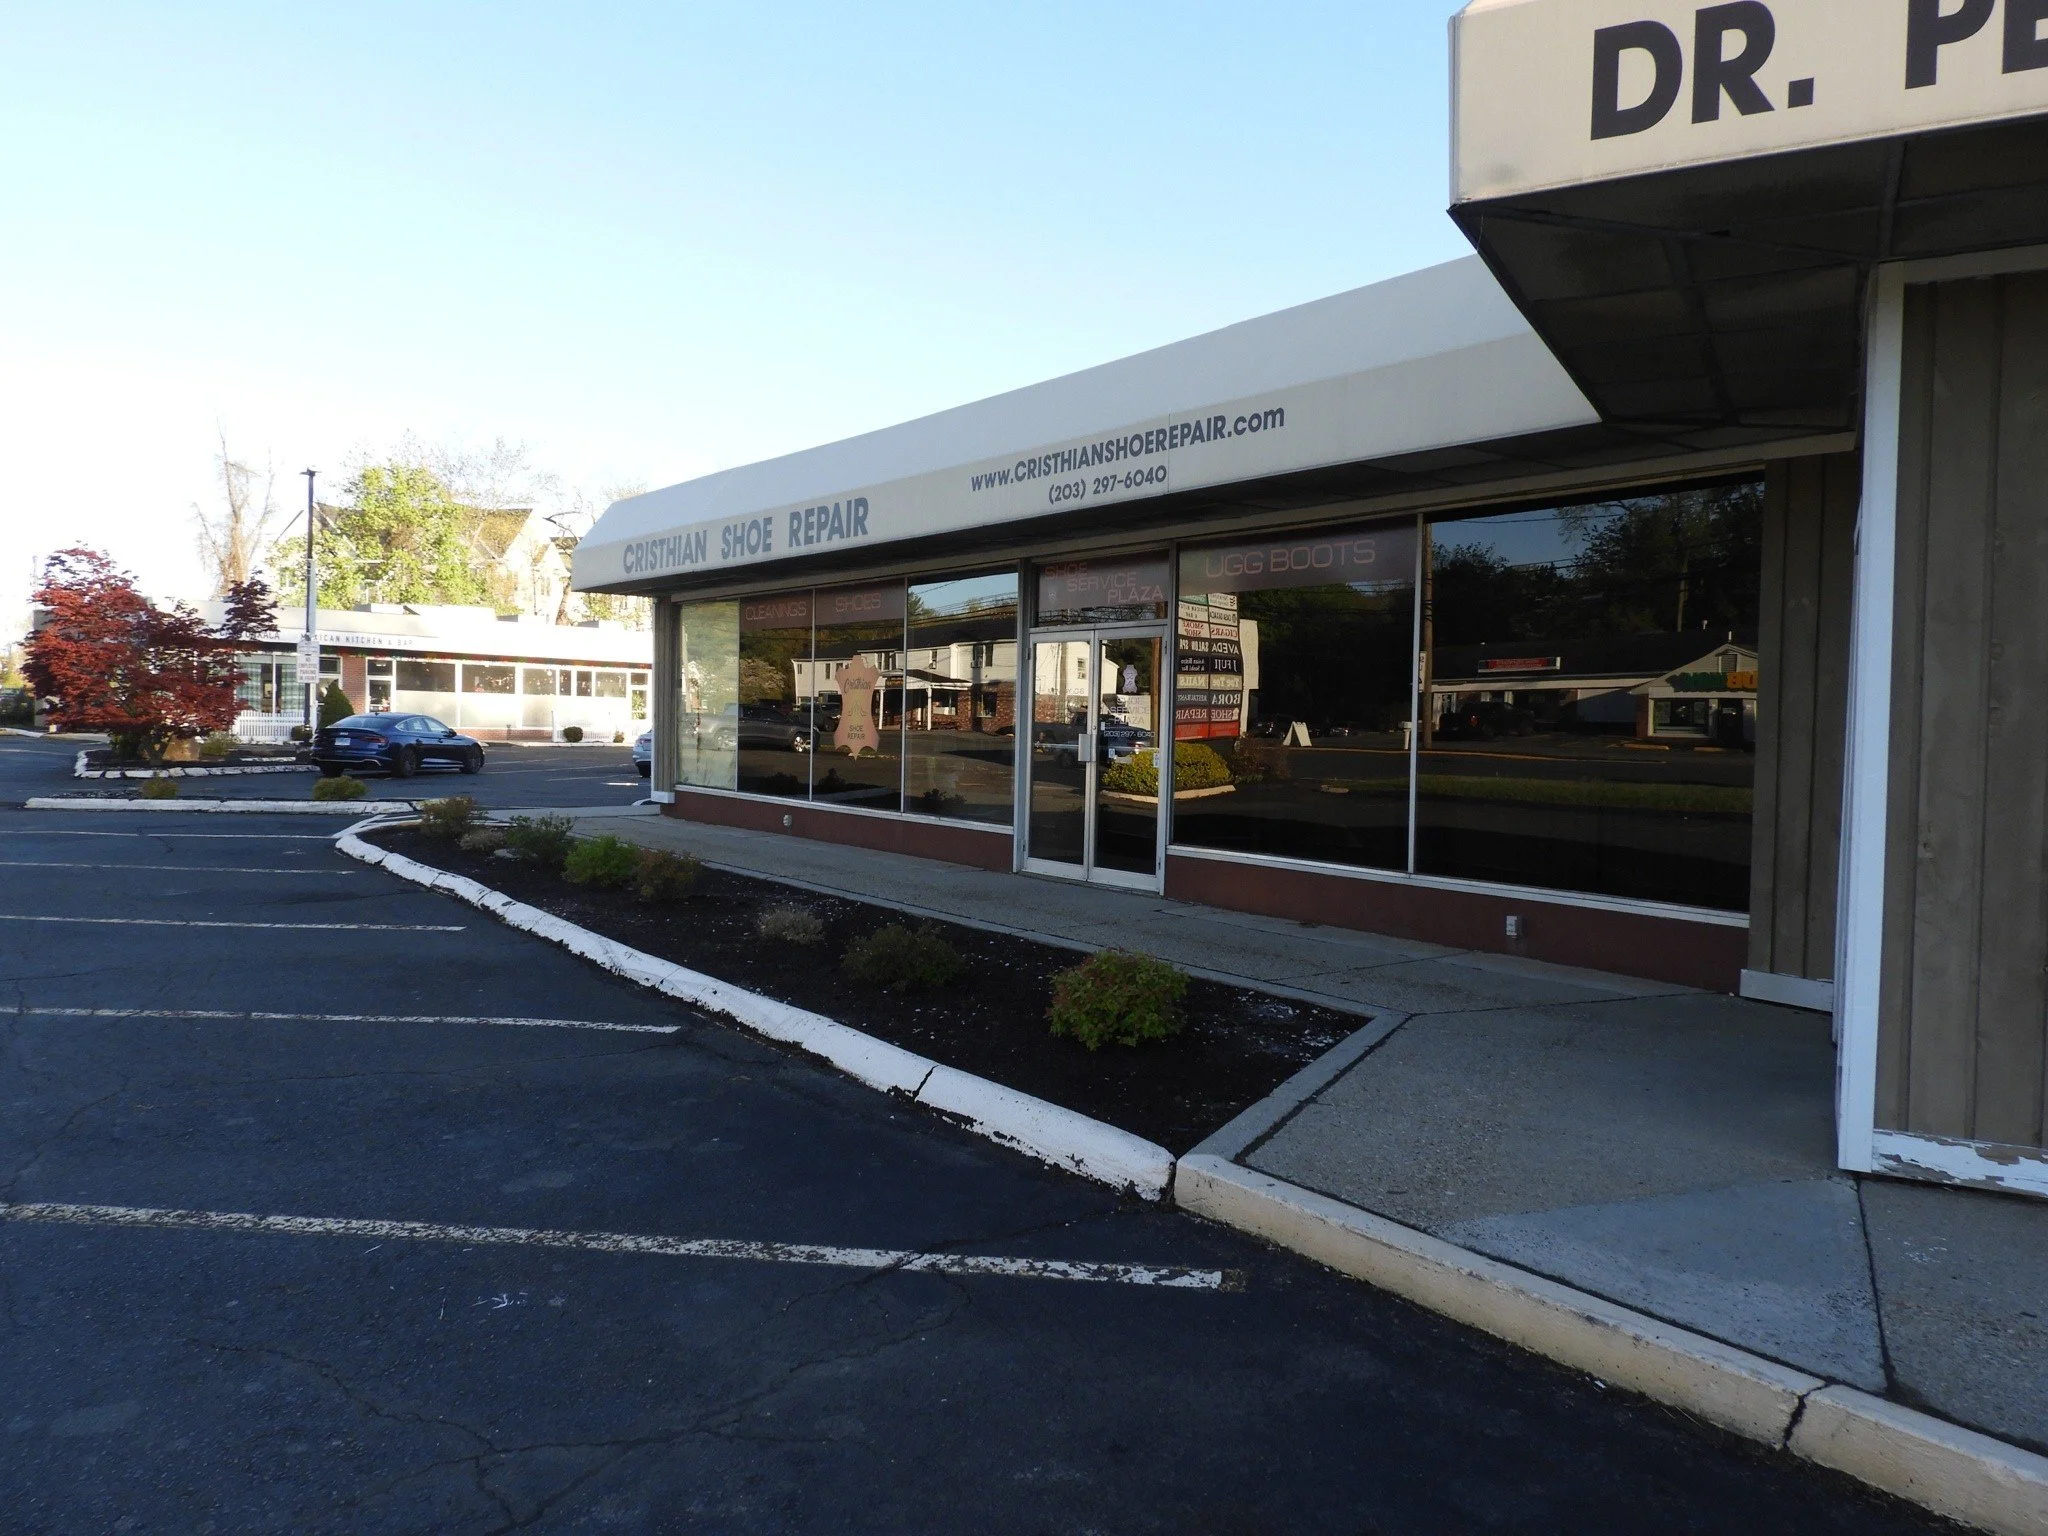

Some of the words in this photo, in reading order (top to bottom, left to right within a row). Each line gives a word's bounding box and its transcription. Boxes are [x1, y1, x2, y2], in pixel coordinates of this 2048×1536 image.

[1590, 0, 1815, 141] DR.
[970, 406, 1285, 492] www.CRISTHIANSHOEREPAIR.com
[1048, 478, 1086, 504] (203)
[1092, 464, 1167, 495] 297-6040
[623, 530, 707, 574] CRISTHIAN
[721, 516, 773, 560] SHOE
[788, 497, 869, 548] REPAIR
[1205, 551, 1264, 578] UGG
[1270, 539, 1376, 572] BOOTS
[1066, 571, 1137, 592] SERVICE
[1107, 585, 1164, 605] PLAZA
[835, 592, 882, 613] SHOES
[301, 633, 340, 642] MXICAN
[345, 635, 383, 645] KITCHEN
[847, 732, 866, 740] REPAIR
